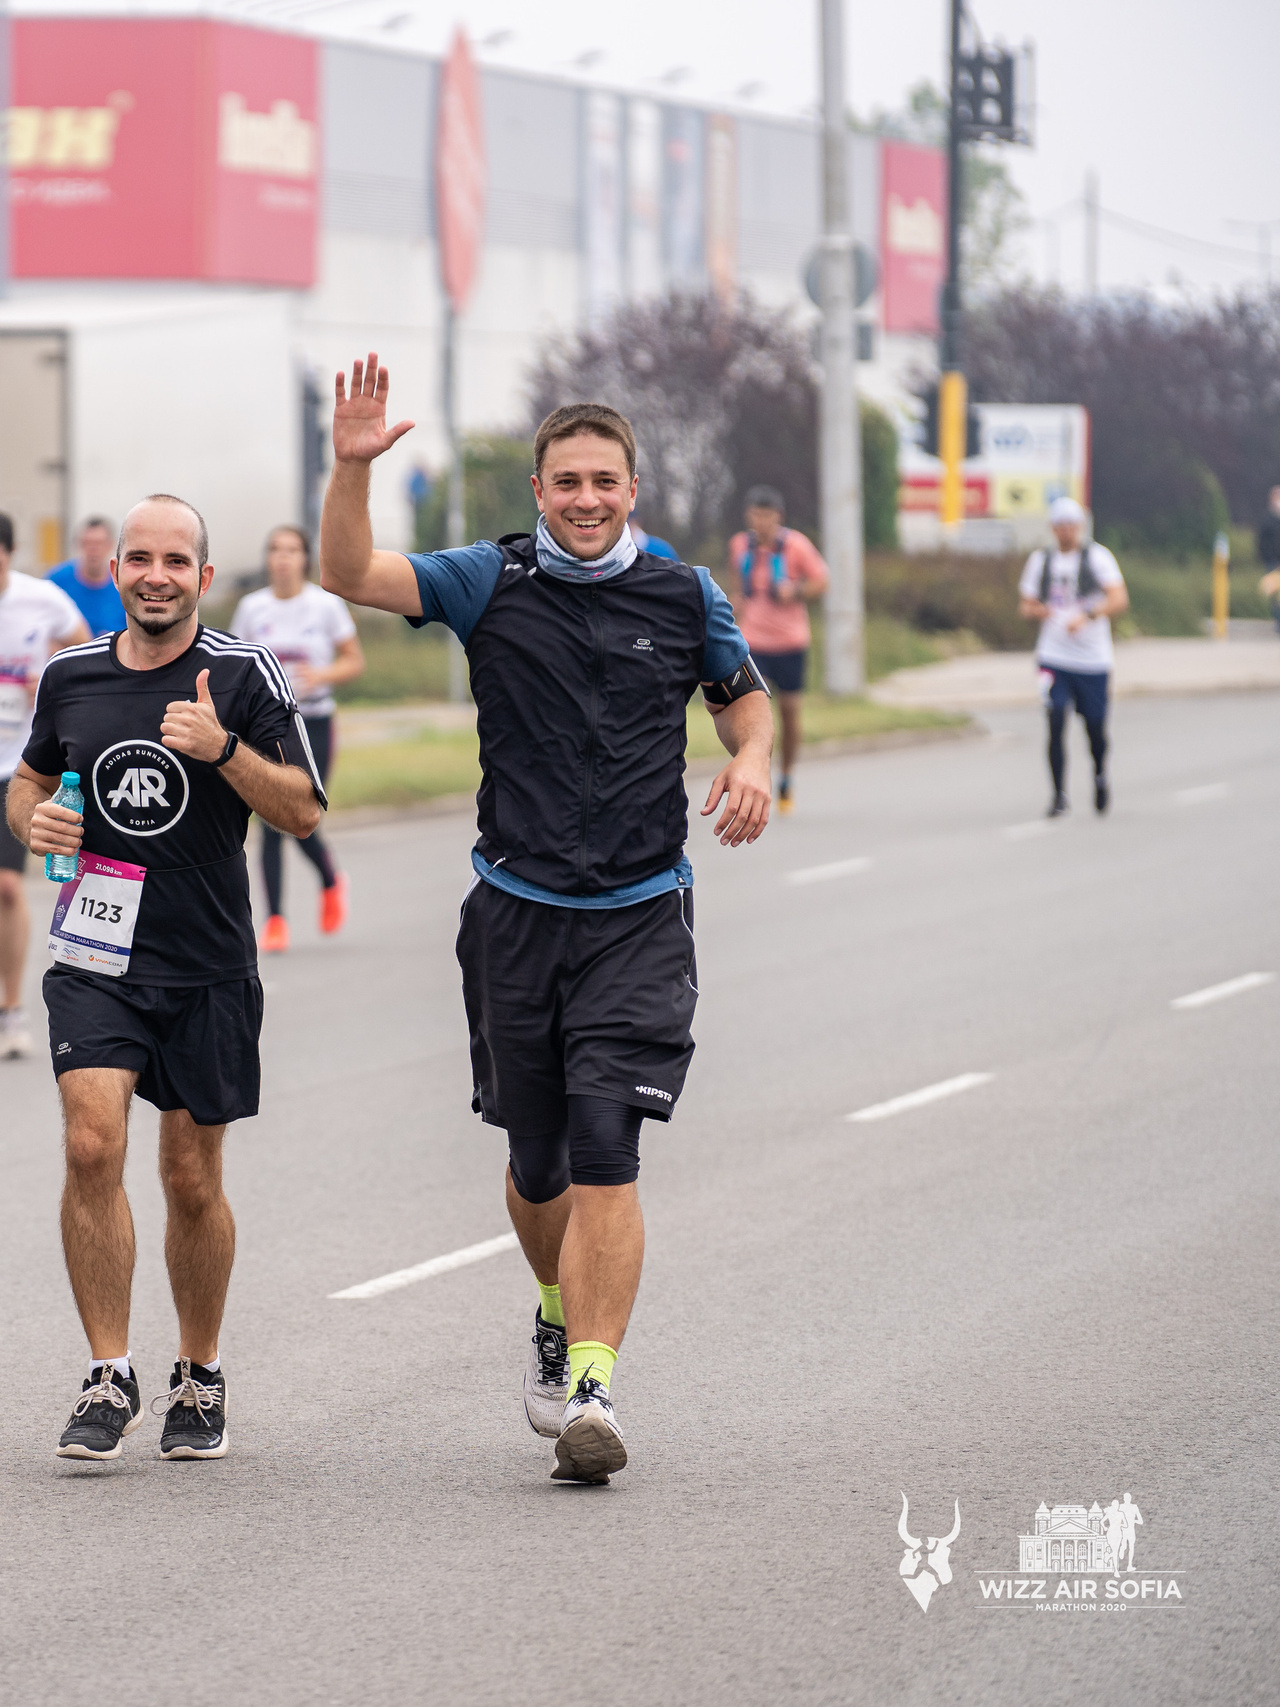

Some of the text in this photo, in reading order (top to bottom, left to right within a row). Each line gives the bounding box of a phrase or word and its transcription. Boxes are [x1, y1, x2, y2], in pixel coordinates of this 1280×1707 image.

[105, 749, 170, 770] ADIDAS RUNNERS
[106, 768, 171, 808] AR
[129, 818, 156, 826] SOFIA
[95, 862, 114, 874] 21.098
[81, 896, 123, 924] 1123
[75, 936, 104, 949] MARATHON
[104, 944, 118, 952] 2020
